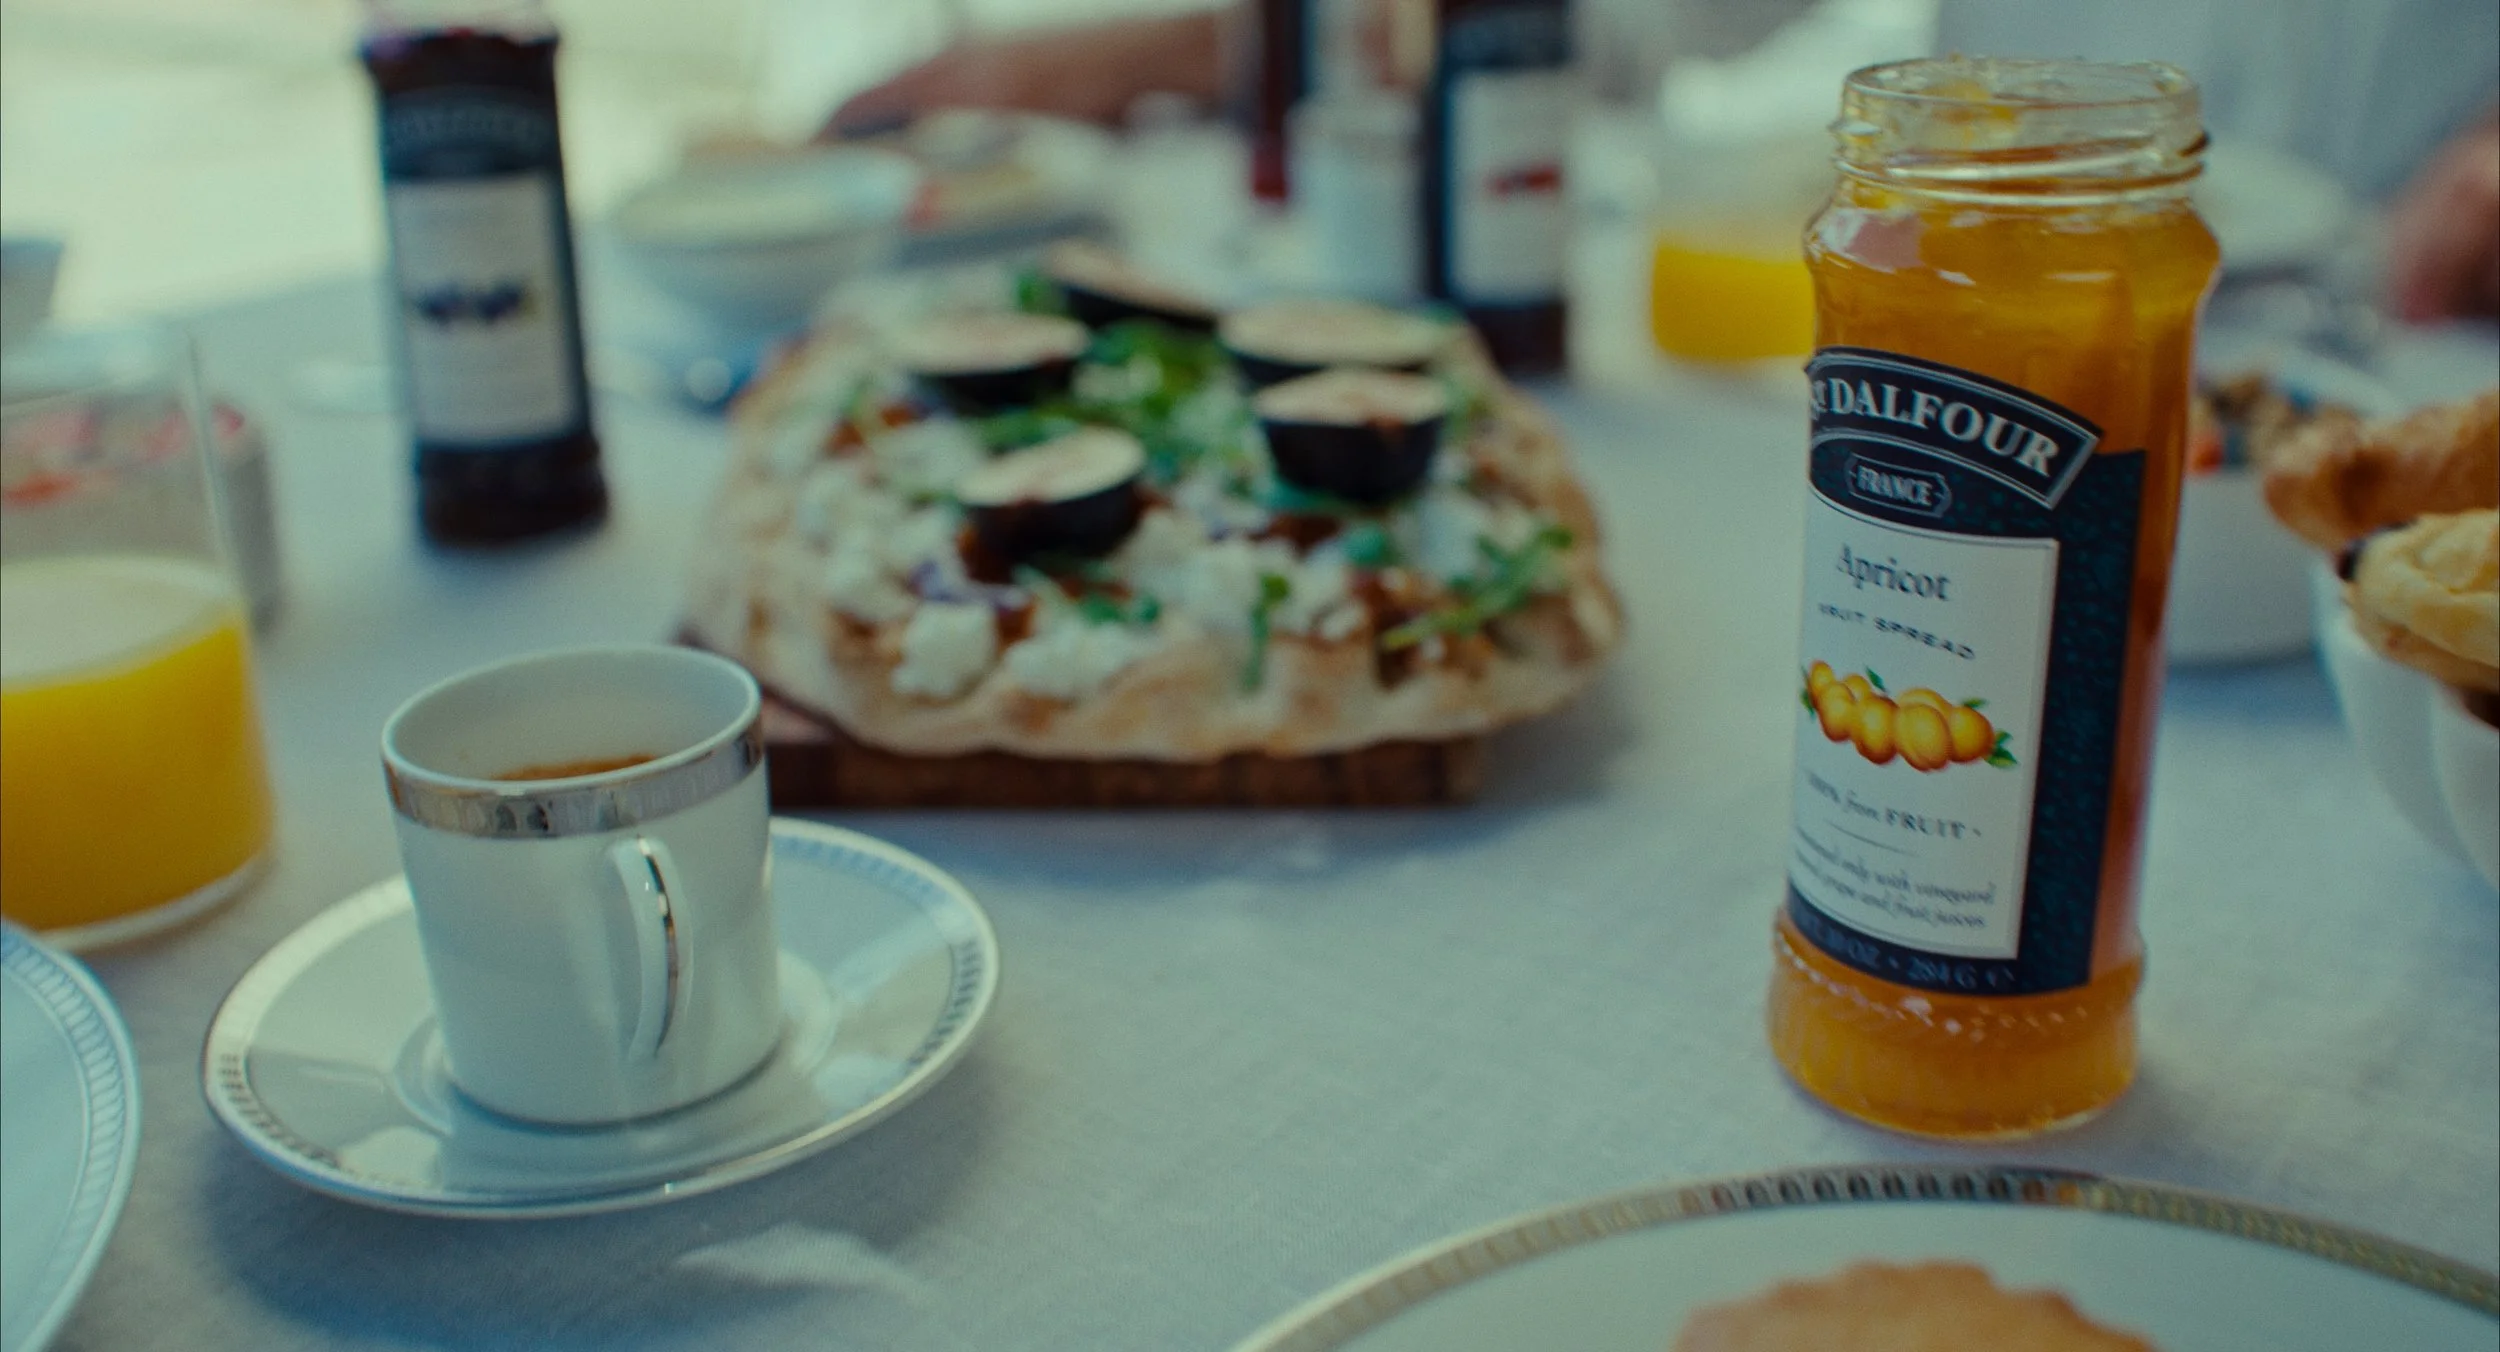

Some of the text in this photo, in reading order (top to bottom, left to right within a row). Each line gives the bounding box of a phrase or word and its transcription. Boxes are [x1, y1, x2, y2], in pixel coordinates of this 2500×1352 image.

[1828, 377, 2060, 478] DALFOUR
[1857, 464, 1934, 507] FRANCE
[1836, 543, 1952, 601] Apricot
[1817, 602, 1976, 661] FRUIT SPREAD
[1883, 806, 1967, 841] FRUIT
